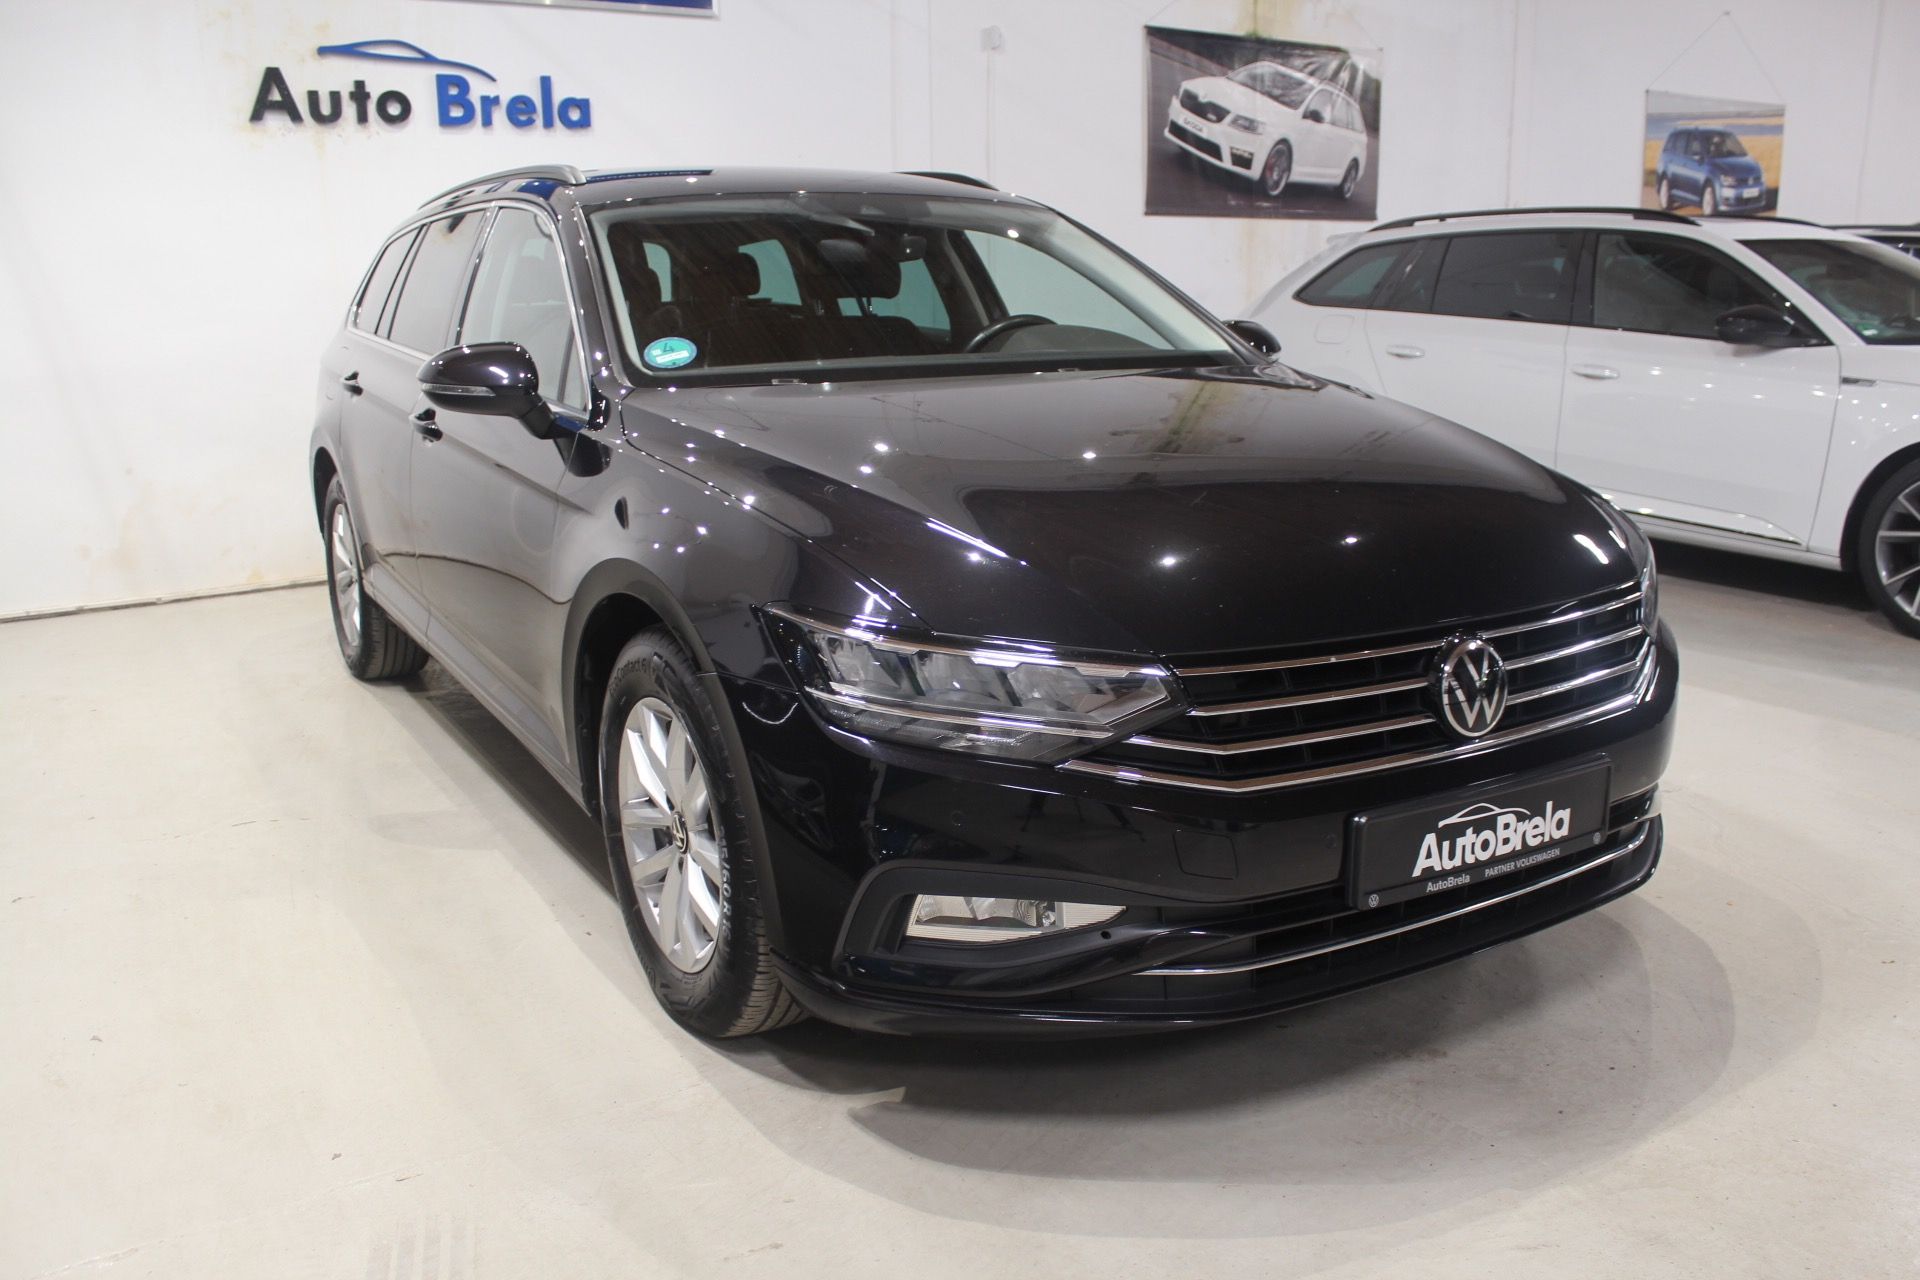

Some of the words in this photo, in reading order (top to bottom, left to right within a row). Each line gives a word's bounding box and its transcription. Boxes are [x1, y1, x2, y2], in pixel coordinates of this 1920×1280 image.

[249, 67, 412, 125] Auto
[435, 73, 592, 129] Brela
[1411, 800, 1571, 878] AutoBrela
[1426, 873, 1471, 893] AutoBrela
[1485, 862, 1515, 878] PARTNER
[1516, 848, 1561, 868] VOLKSWAGEN
